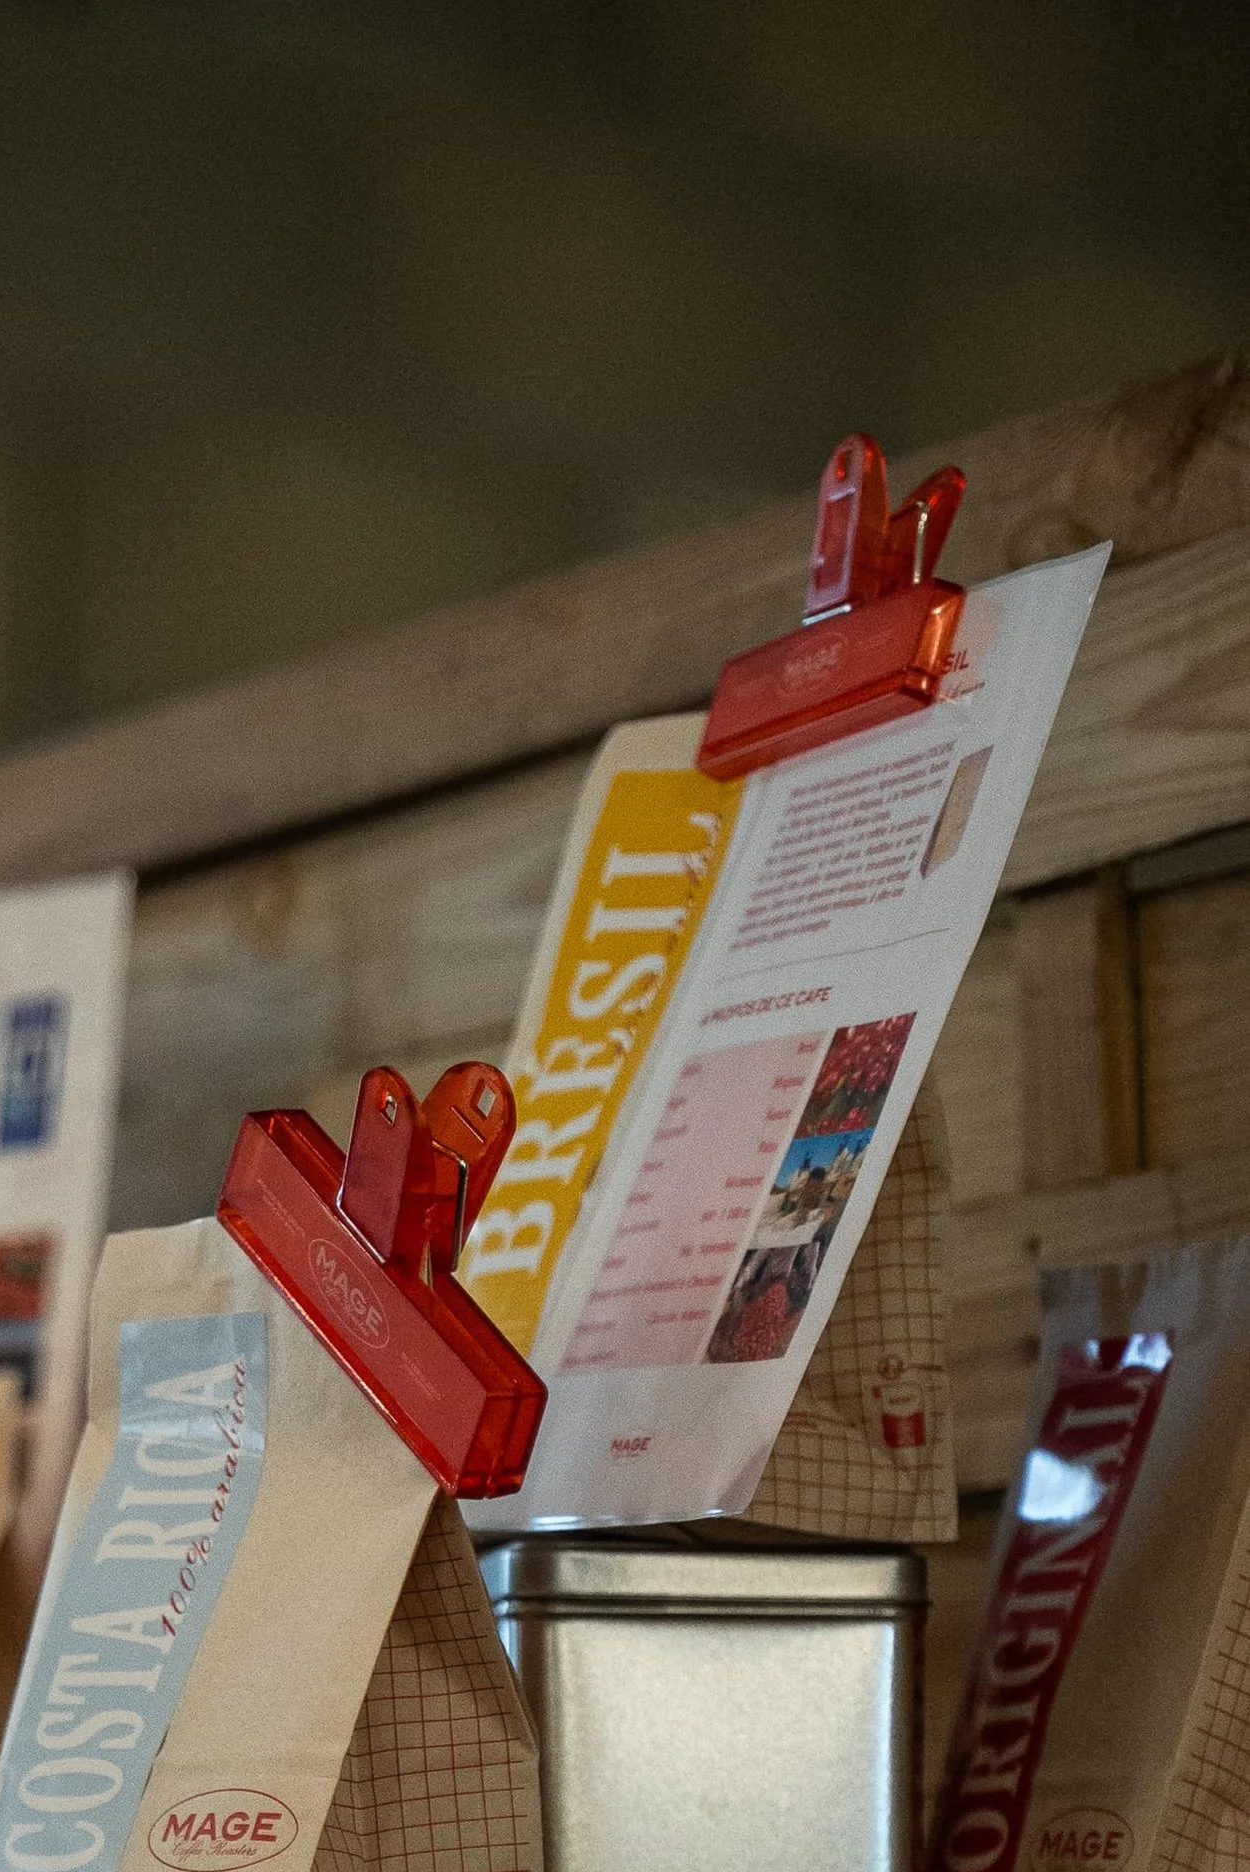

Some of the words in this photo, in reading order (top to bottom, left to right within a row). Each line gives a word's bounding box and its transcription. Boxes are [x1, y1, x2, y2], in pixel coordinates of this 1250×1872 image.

[315, 1247, 384, 1338] MAGE
[95, 1360, 248, 1564] RICA
[609, 1436, 652, 1452] MAGE
[160, 1531, 213, 1639] 100%
[211, 1359, 248, 1524] arabica
[161, 1811, 283, 1844] MAGE
[1038, 1830, 1125, 1861] MAGE
